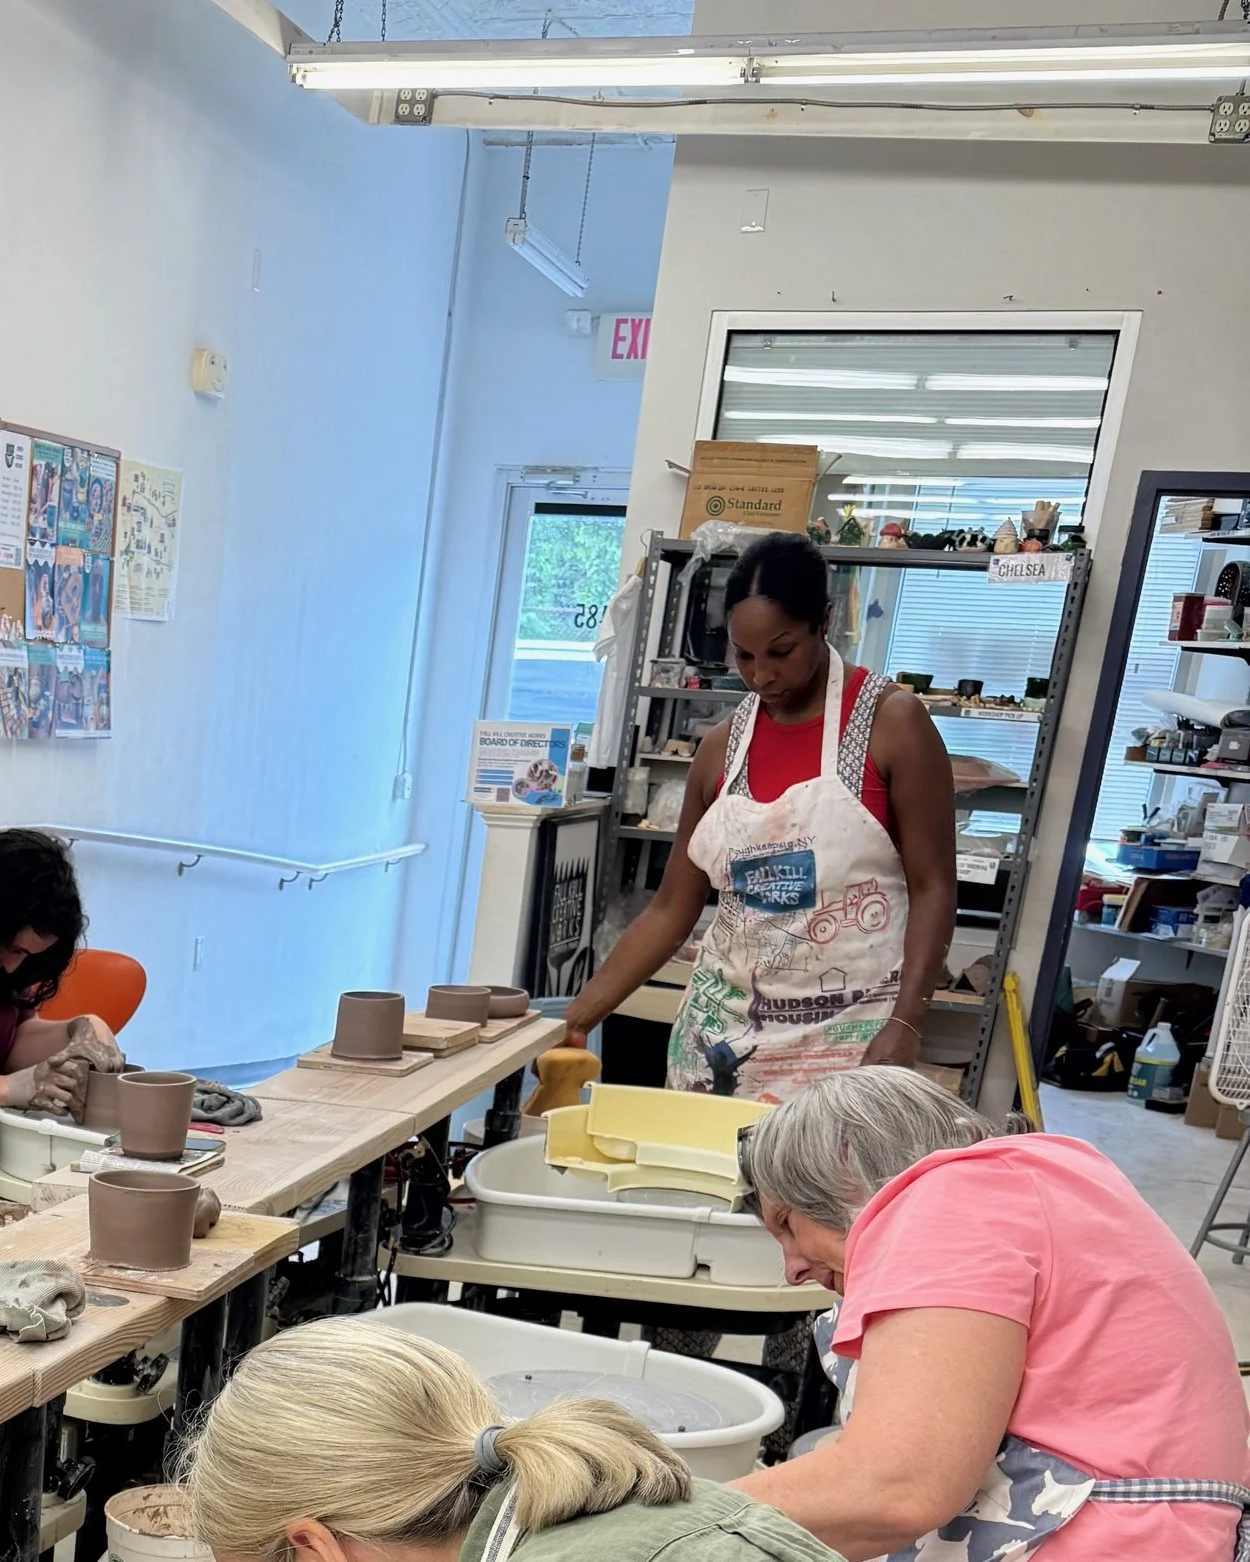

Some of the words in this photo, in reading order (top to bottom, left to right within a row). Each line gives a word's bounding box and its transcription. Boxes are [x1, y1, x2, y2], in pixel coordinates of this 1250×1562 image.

[611, 318, 652, 360] EXI
[726, 497, 782, 511] Standard
[998, 564, 1045, 577] CHELSEA
[479, 738, 508, 746] BOARD
[508, 738, 520, 746] OF
[520, 739, 566, 749] DIRECTORS
[746, 881, 803, 895] CREATIVE
[760, 993, 844, 1012] HUDSON
